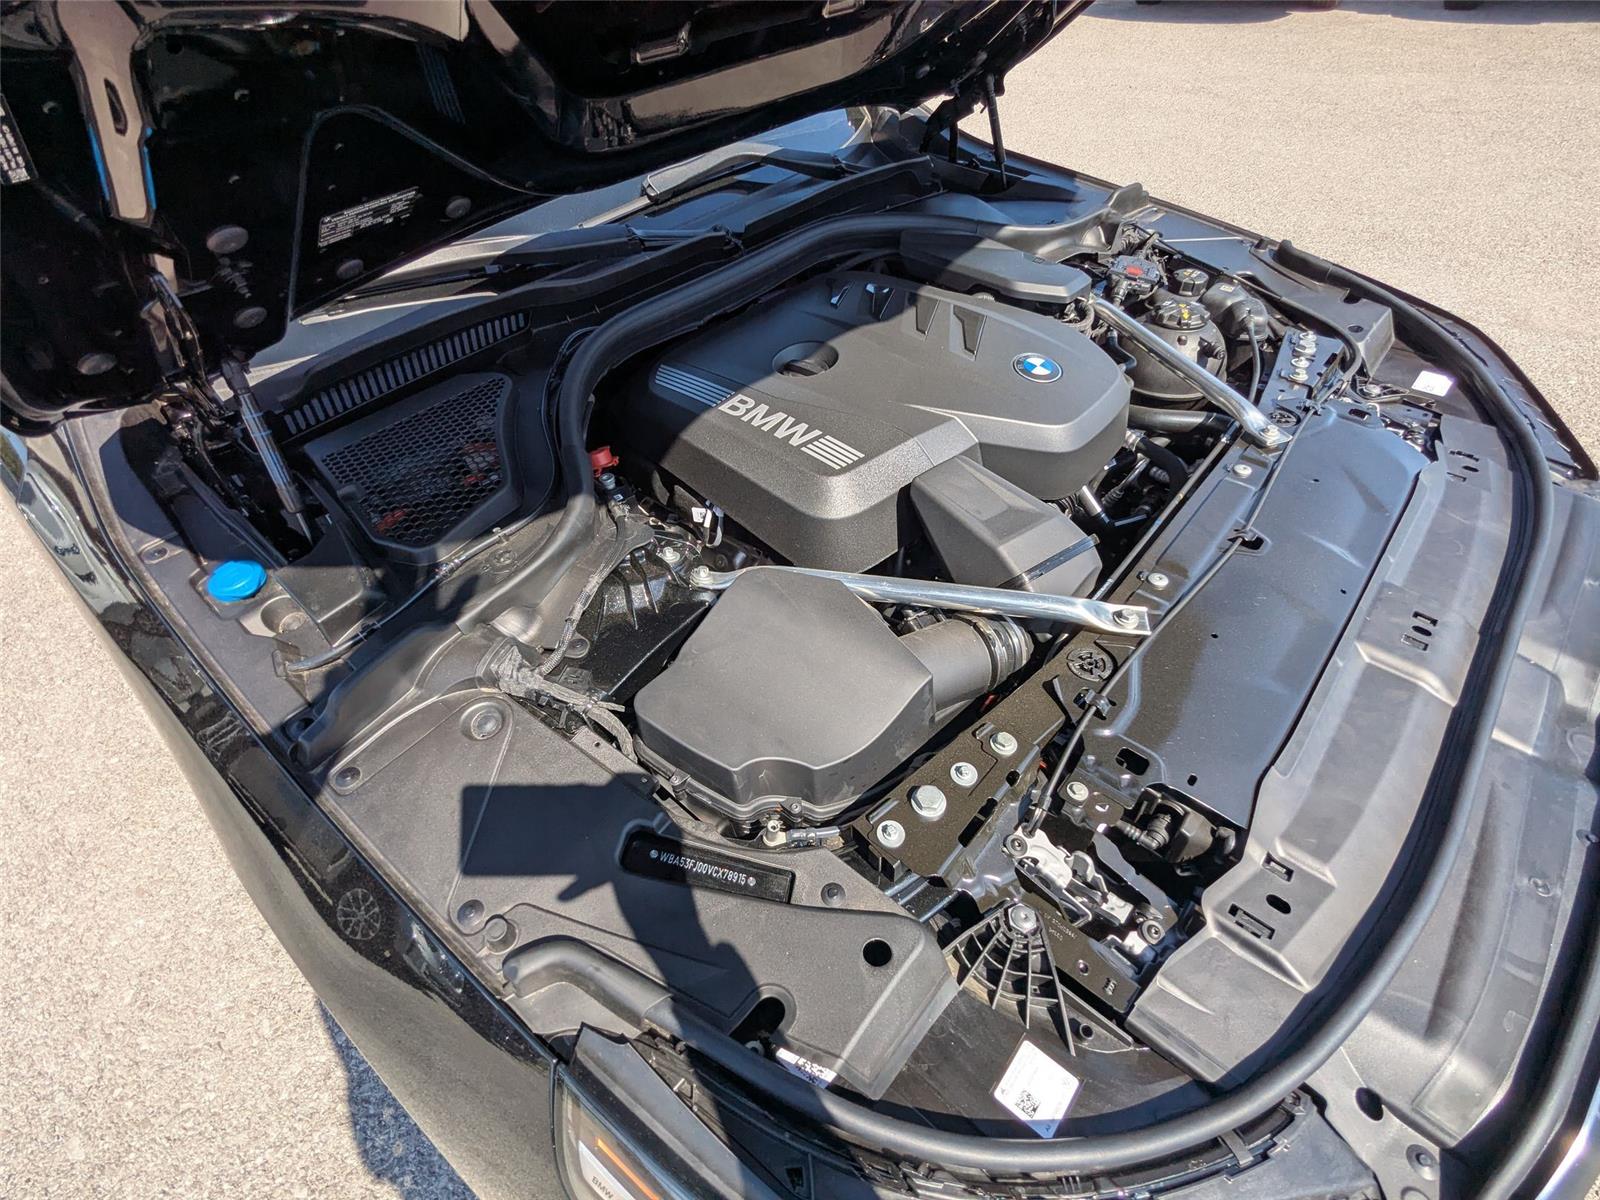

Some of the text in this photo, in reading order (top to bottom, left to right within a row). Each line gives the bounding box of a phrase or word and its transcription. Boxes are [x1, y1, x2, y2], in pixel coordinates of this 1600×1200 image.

[718, 393, 823, 447] BMW
[659, 851, 747, 886] WBA53FJ00VCX78915
[591, 1175, 614, 1199] BMW
